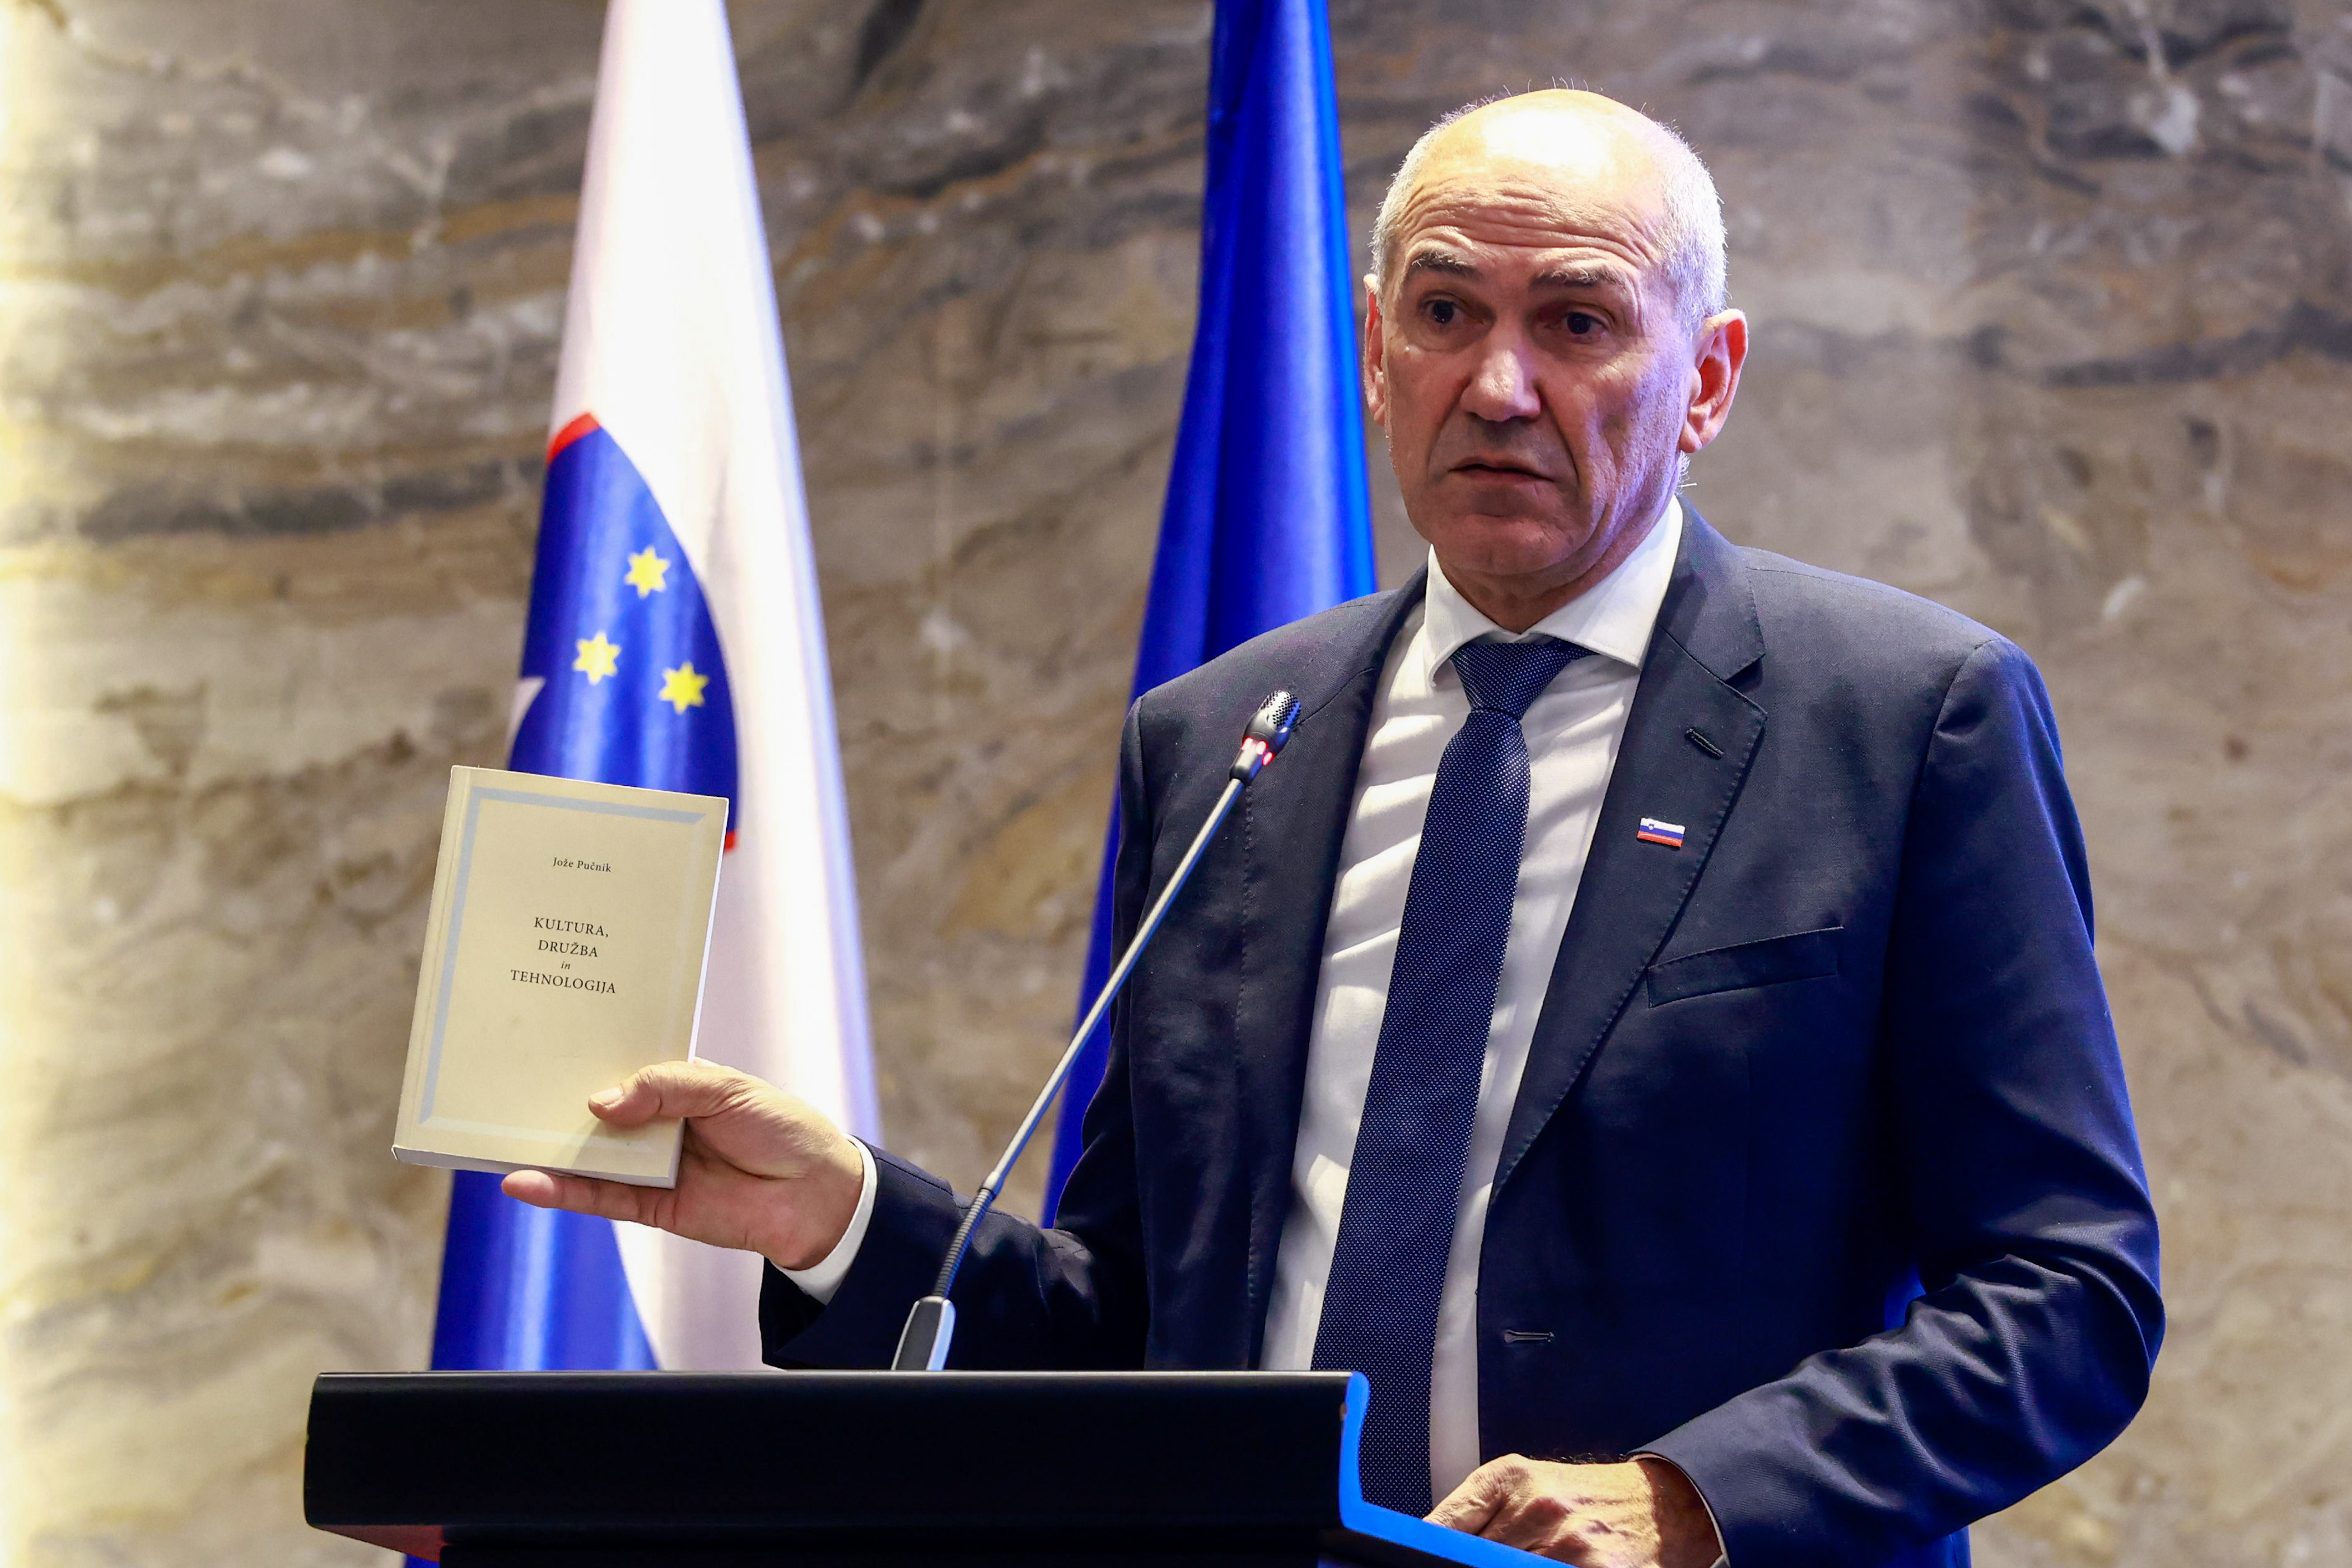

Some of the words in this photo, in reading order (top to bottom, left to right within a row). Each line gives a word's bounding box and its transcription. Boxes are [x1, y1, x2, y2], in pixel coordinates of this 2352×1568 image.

[553, 857, 573, 867] Jože
[577, 860, 612, 872] Pučnik
[534, 917, 609, 938] KULTURA,
[538, 940, 598, 957] DRUŽBA
[561, 961, 571, 969] in
[510, 969, 616, 994] TEHNOLOGIJA
